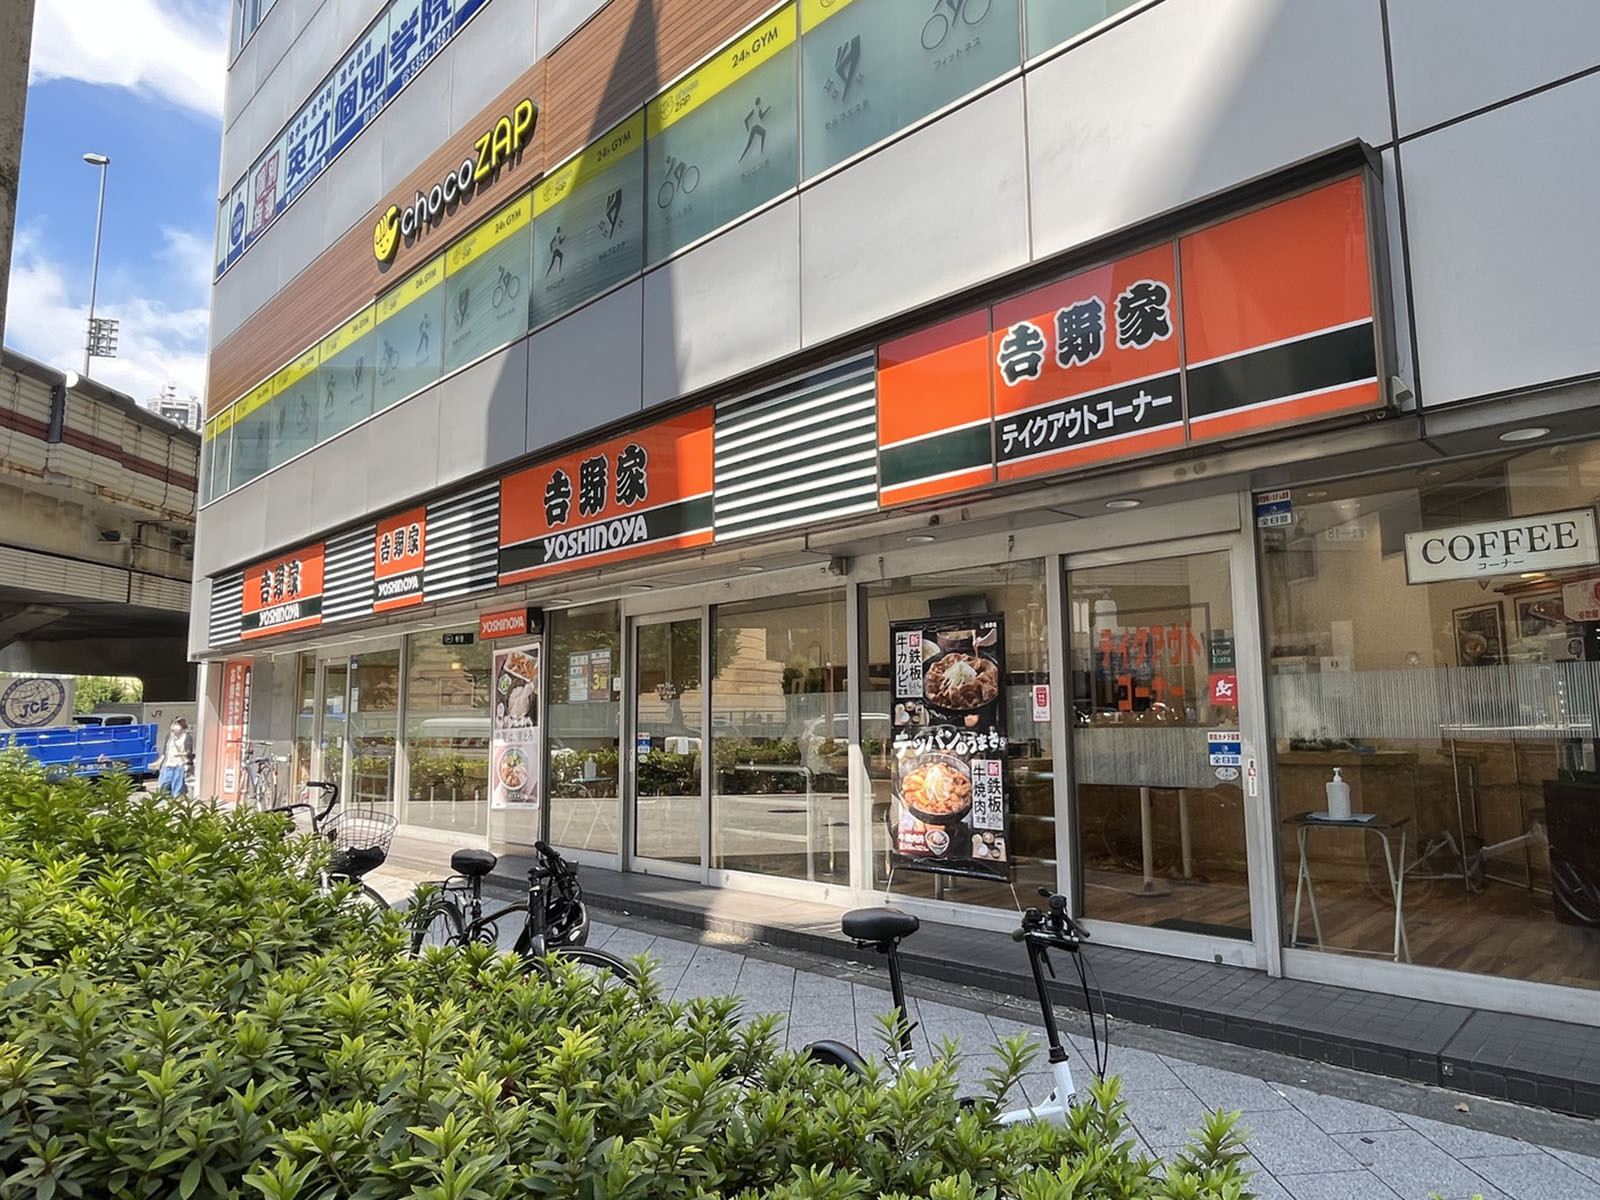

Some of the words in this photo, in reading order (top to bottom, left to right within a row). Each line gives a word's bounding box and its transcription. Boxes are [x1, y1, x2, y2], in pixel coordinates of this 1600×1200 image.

[751, 27, 778, 53] GYM
[611, 130, 632, 151] GYM
[401, 98, 535, 236] chocoZAP
[997, 279, 1173, 387] 吉野家
[1002, 390, 1172, 453] テイクアウトコーナー
[543, 443, 648, 528] 吉野家
[378, 522, 421, 565] 吉野家
[543, 514, 648, 562] YOSHINOYA
[1422, 521, 1579, 565] COFFEE
[260, 559, 303, 606] 吉野家
[1478, 558, 1525, 571] コーナー
[377, 576, 419, 597] YOSHINOYA
[258, 602, 300, 627] YOSHINOYA
[482, 616, 525, 634] YOSHINOYA
[896, 634, 908, 688] 牛カルビ
[909, 649, 921, 681] 鉄板
[1099, 621, 1201, 670] テイクアウト
[19, 696, 50, 718] JCE
[973, 764, 986, 815] 牛焼肉
[988, 778, 1001, 812] 鉄板
